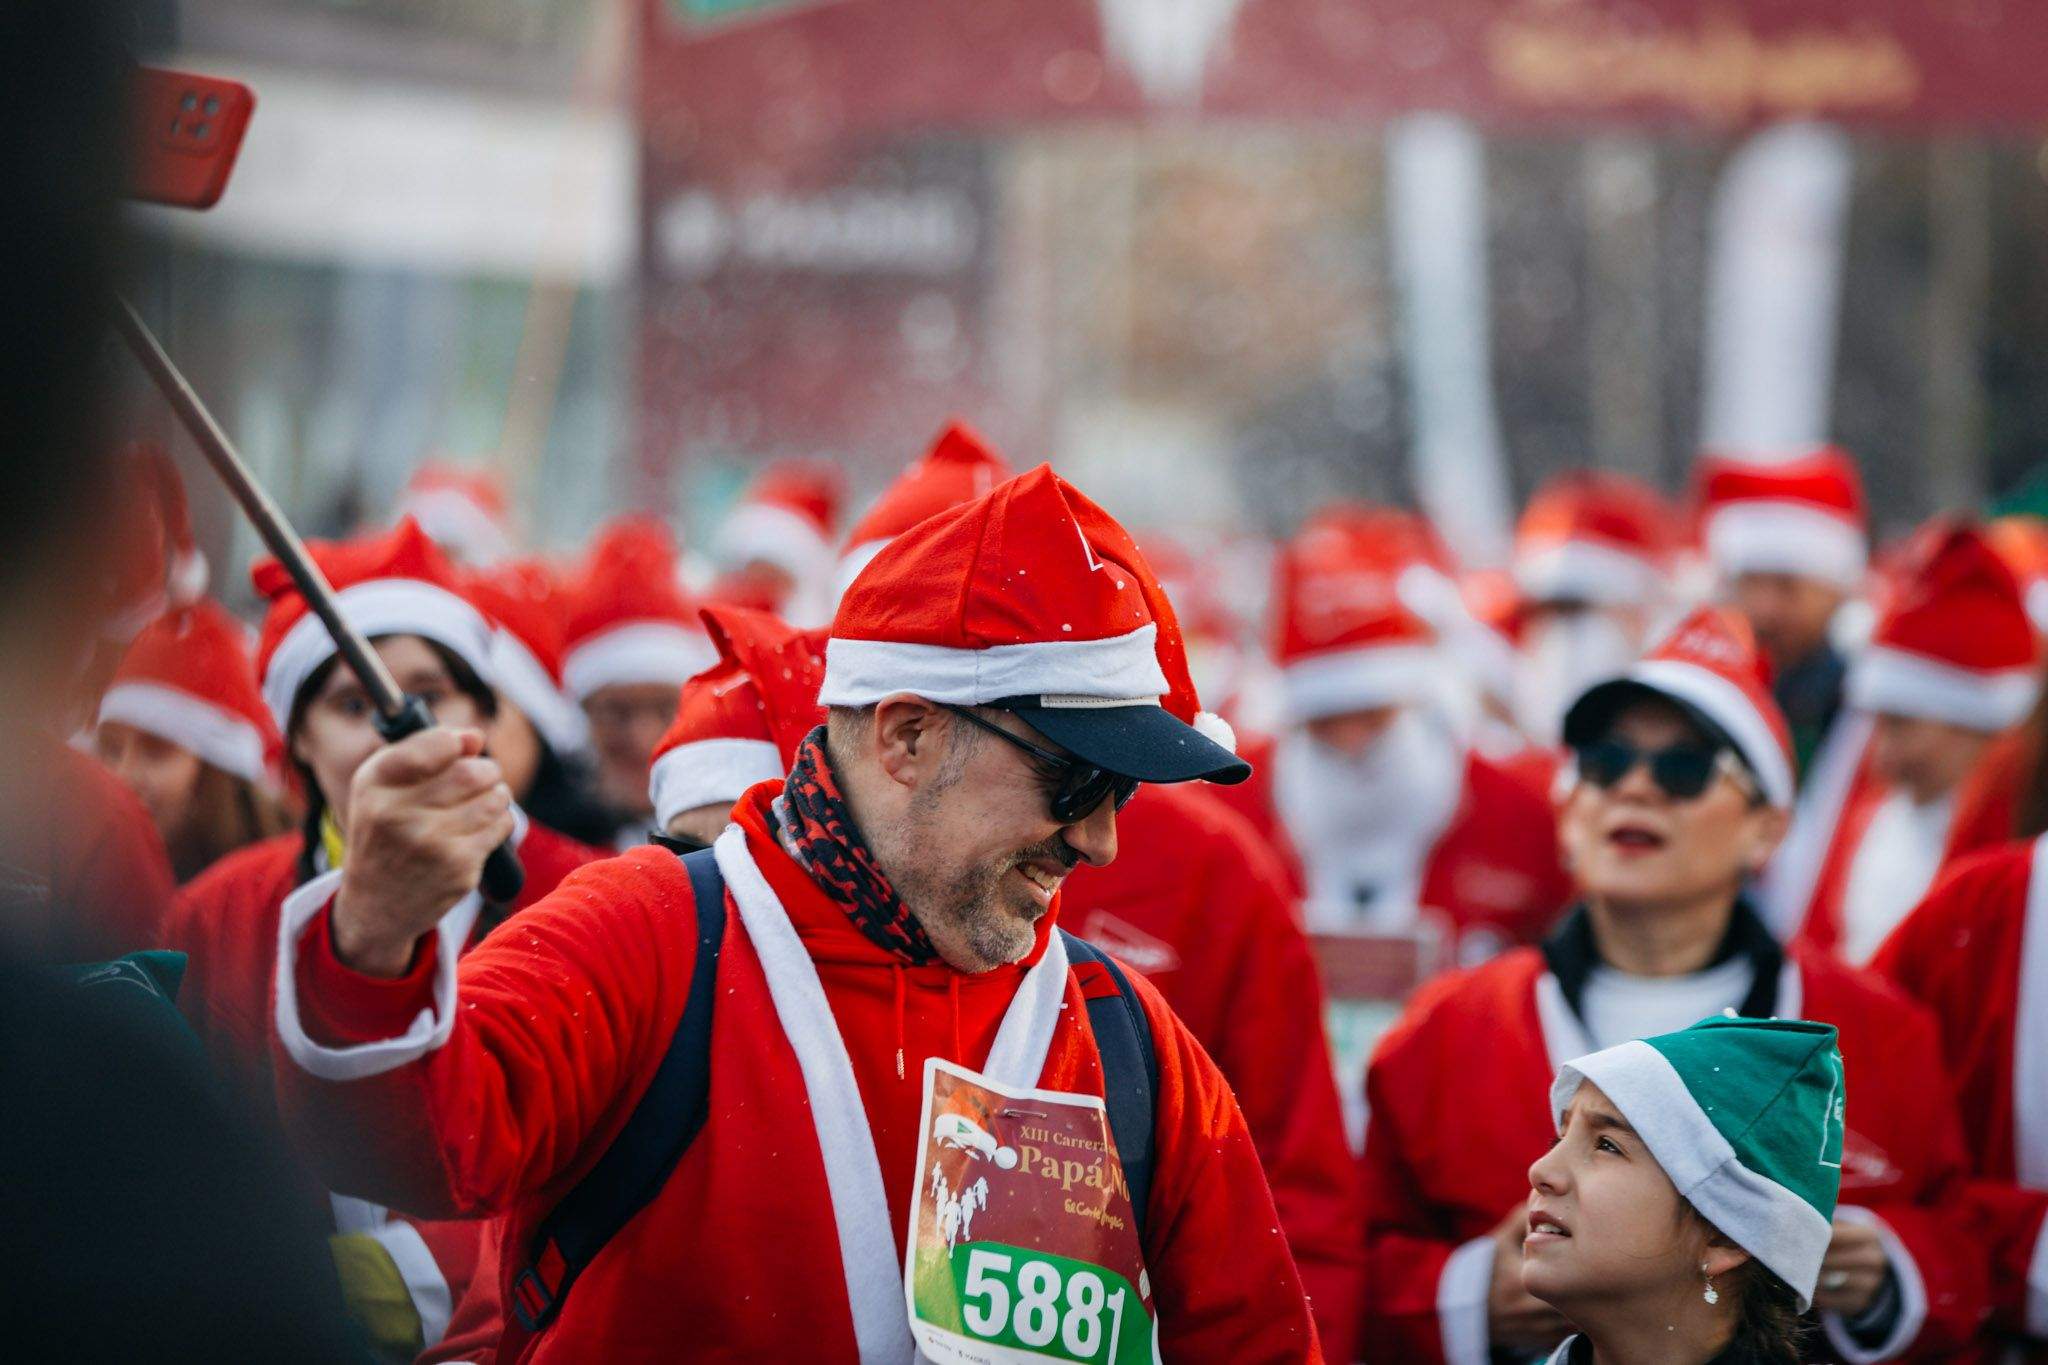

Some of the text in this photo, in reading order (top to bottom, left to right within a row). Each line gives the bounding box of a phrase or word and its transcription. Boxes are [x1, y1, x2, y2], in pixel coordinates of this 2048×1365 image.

[1021, 1126, 1049, 1142] XIII
[1053, 1131, 1107, 1152] Carrera
[1019, 1145, 1103, 1191] Papá
[963, 1249, 1126, 1365] 5881
